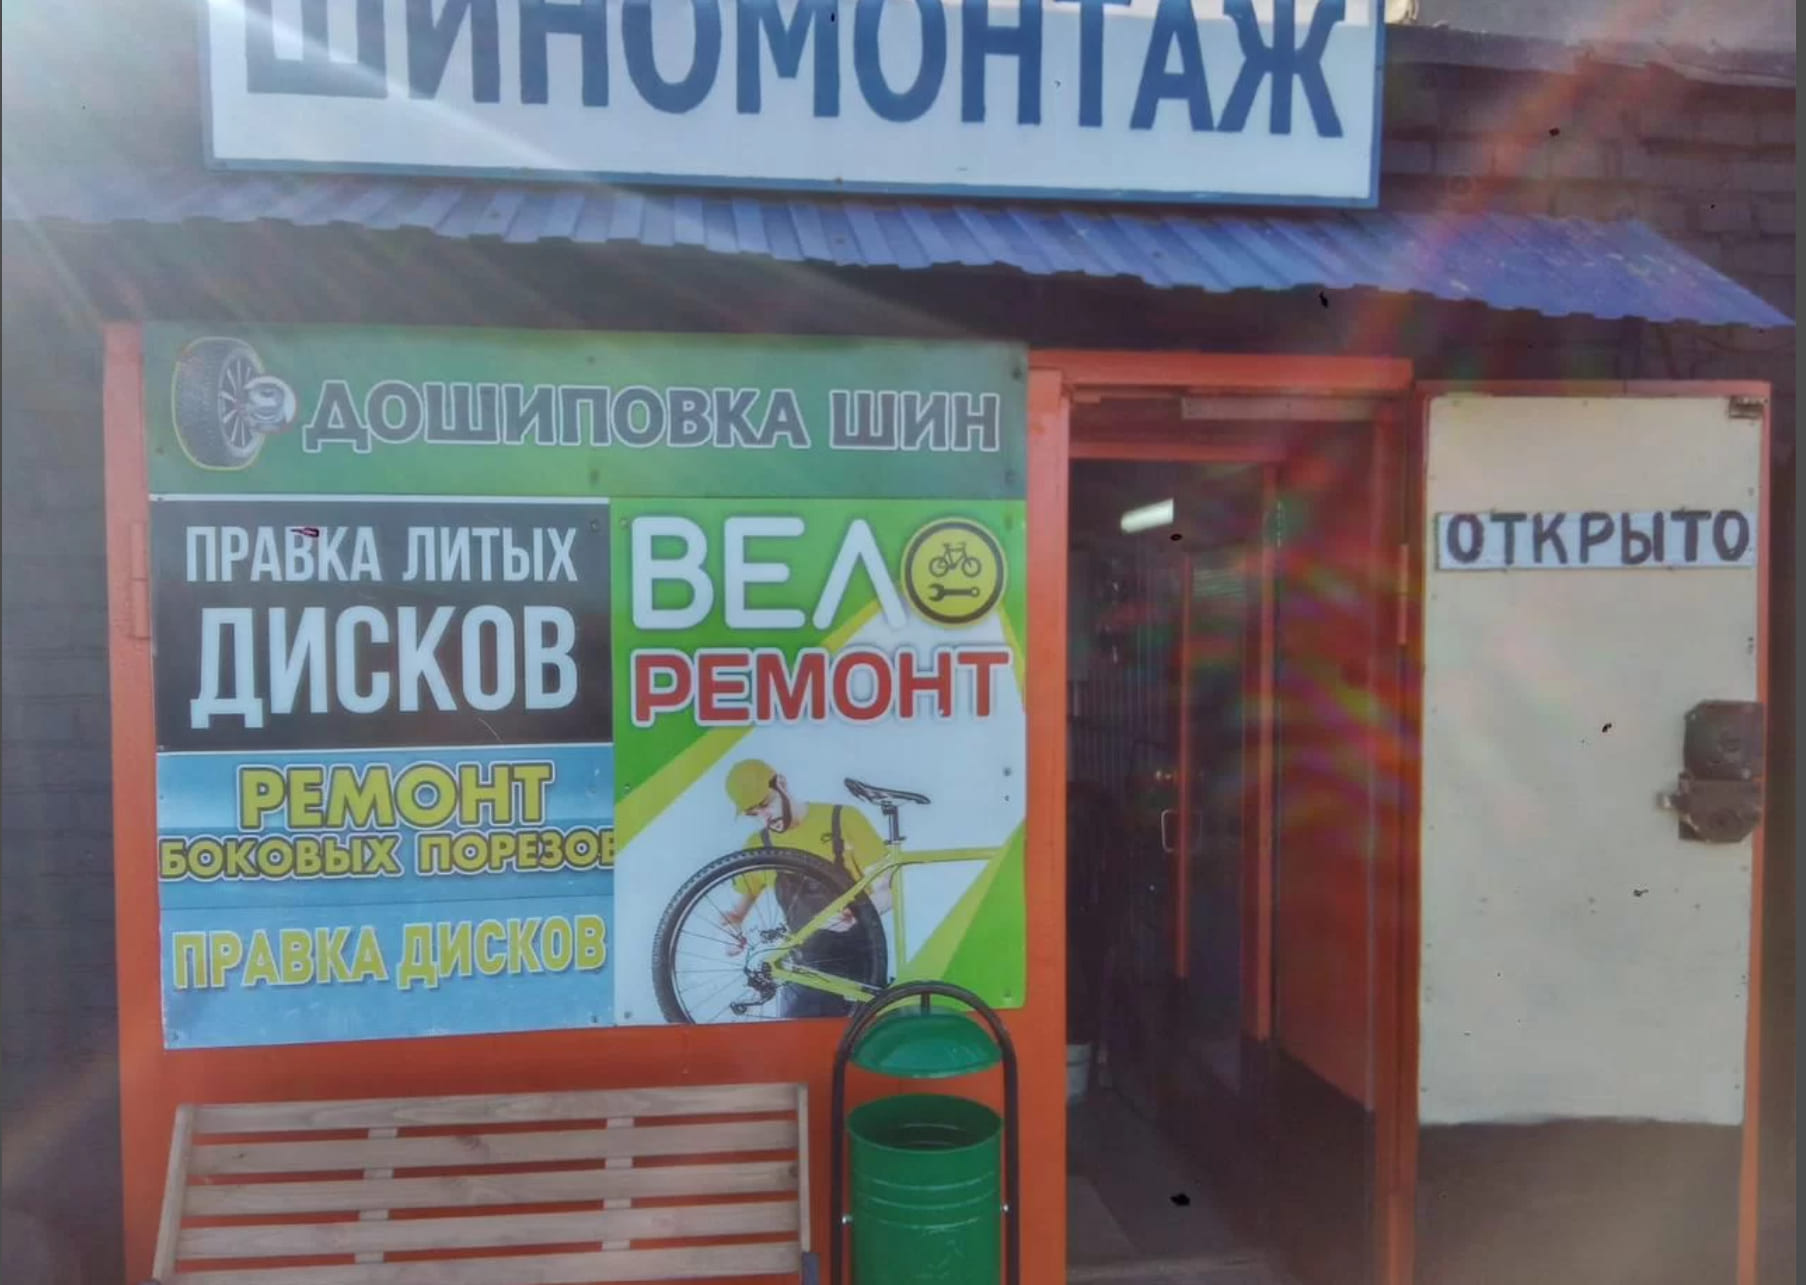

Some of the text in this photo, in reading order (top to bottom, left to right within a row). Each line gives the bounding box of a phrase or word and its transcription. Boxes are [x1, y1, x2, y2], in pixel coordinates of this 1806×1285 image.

[245, 0, 1343, 138] ШИНОМОНТАЖ
[301, 380, 1001, 455] ДОШИПОВКА ШИН
[185, 525, 578, 582] ПРАВКА ЛИТЫХ
[1446, 509, 1751, 565] ОТКРЫТО
[189, 604, 578, 729] ДИСКОВ
[630, 646, 1014, 728] РЕМОНТ
[236, 760, 555, 830] РЕМОНТ
[159, 834, 403, 881] БОКОВЫХ
[172, 914, 607, 989] ПРАВКА ДИСКОВ
